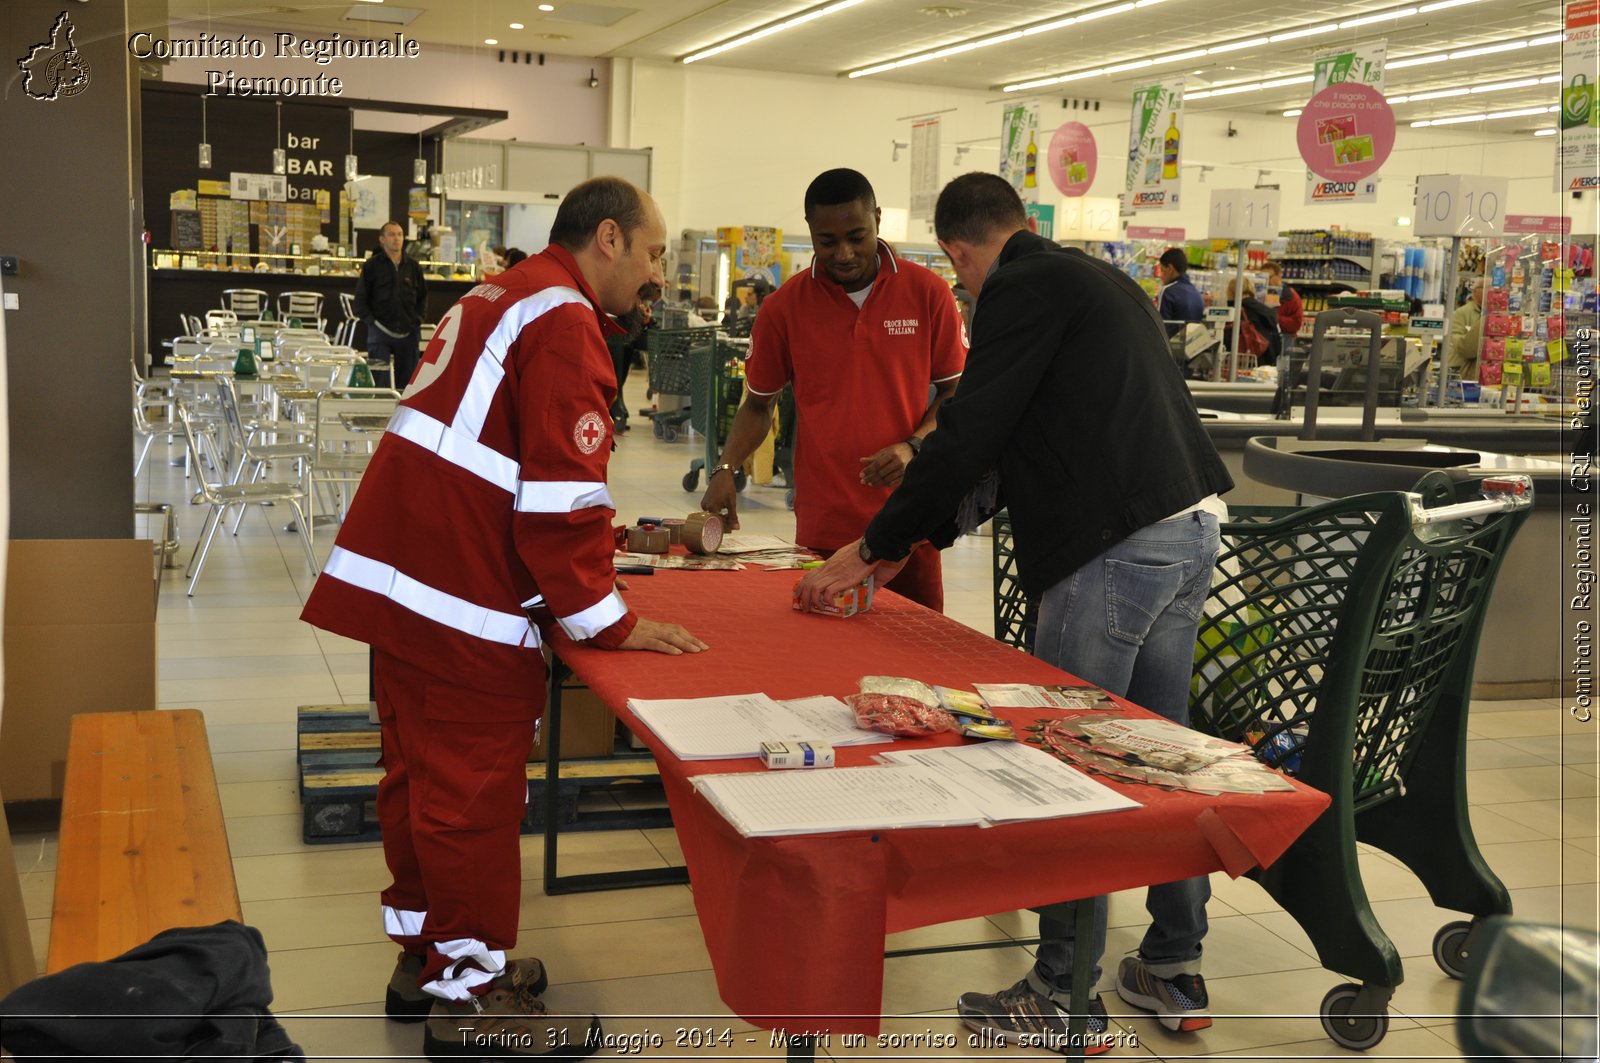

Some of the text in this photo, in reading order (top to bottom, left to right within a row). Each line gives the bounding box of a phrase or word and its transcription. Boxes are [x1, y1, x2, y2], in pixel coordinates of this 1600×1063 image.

[1313, 100, 1331, 108] che
[1339, 93, 1367, 102] regalo
[288, 132, 320, 150] bar
[288, 158, 334, 176] BAR
[288, 184, 318, 201] bar
[1313, 181, 1356, 196] MERCATO
[1133, 191, 1166, 204] MERCATO
[1215, 202, 1232, 227] 11
[1246, 202, 1270, 228] 11
[1422, 191, 1452, 222] 10
[1465, 191, 1498, 223] 10
[1087, 208, 1113, 231] 12
[883, 319, 919, 328] CROCE ROSSA
[888, 327, 916, 335] ITALIANA
